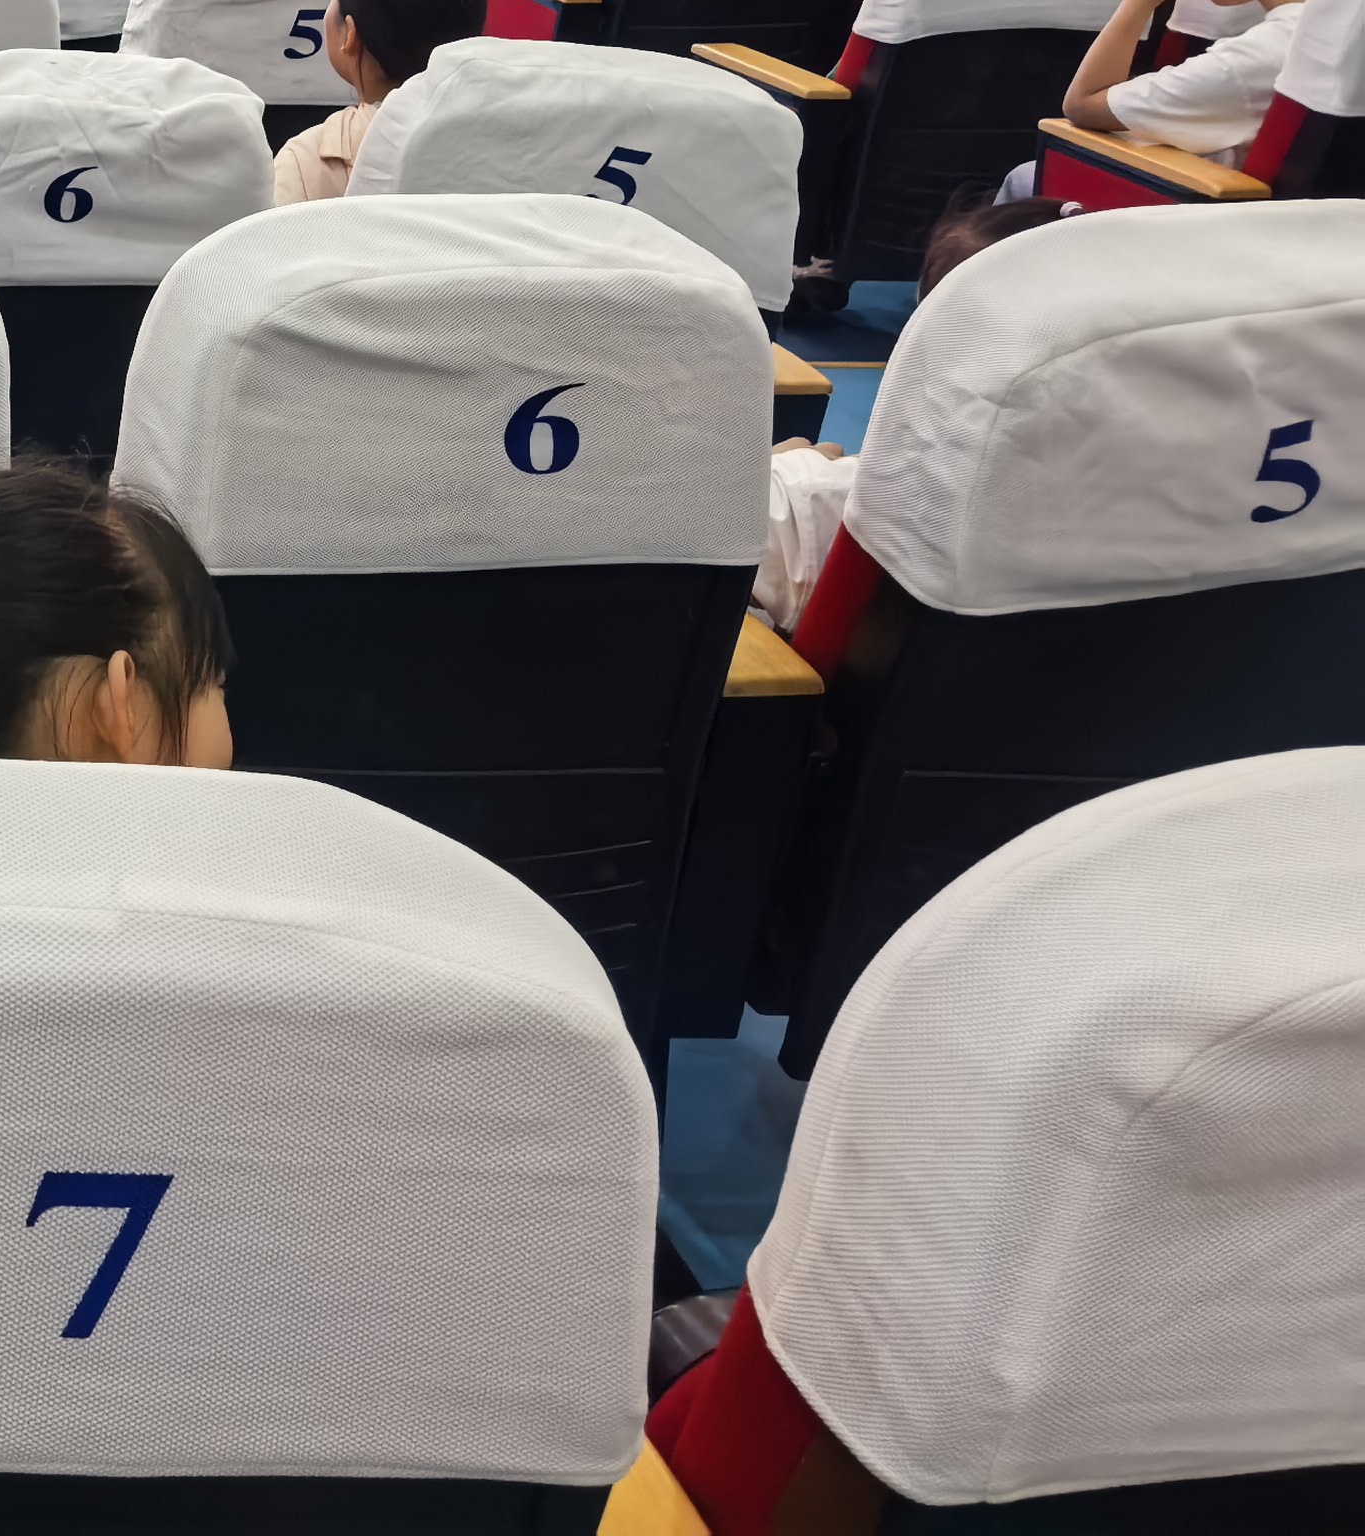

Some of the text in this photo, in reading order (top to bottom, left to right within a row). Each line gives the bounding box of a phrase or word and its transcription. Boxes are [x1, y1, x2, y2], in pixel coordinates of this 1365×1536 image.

[283, 9, 325, 60] 5
[43, 166, 99, 224] 6
[584, 146, 653, 206] 5
[503, 381, 588, 475] 6
[1250, 419, 1321, 524] 5
[25, 1170, 175, 1340] 7
